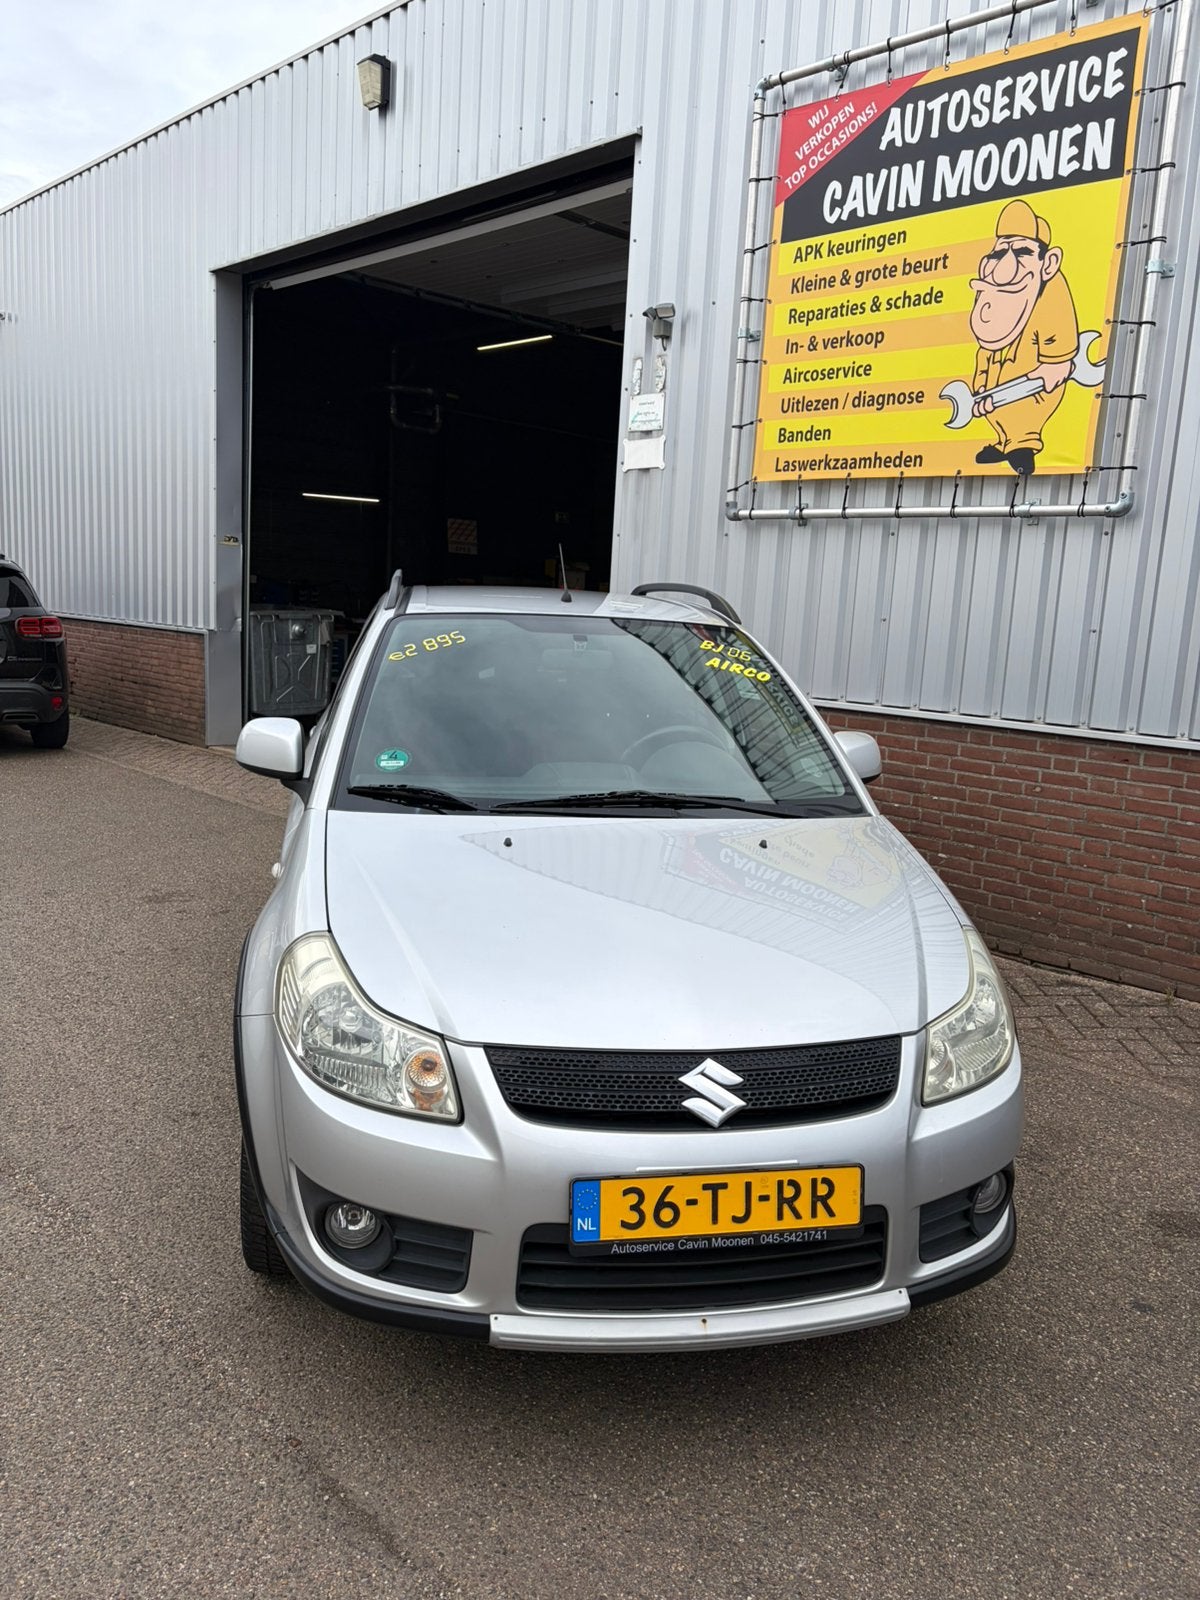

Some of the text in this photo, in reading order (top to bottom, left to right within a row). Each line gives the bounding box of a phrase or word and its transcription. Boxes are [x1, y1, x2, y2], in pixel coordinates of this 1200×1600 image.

[879, 48, 1129, 151] AUTOSERVICE
[808, 104, 830, 129] WIJ
[794, 101, 855, 161] VERKOPEN
[784, 101, 878, 190] TOP OCCASIONS!
[823, 118, 1116, 224] CAVIN MOONEN
[793, 230, 907, 264] APK keuringen
[790, 253, 948, 294] Kleine & grote beurt
[788, 286, 944, 326] Reparaties & schade
[785, 330, 885, 355] In- & verkoop
[783, 361, 872, 384] Aircoservice
[780, 389, 925, 413] Uitlezen / diagnose
[777, 425, 832, 444] Banden
[774, 450, 924, 473] Laswerkzaamheden
[699, 639, 753, 663] BJ 06
[704, 656, 773, 684] AIRCO
[620, 1177, 836, 1230] 36-TJ-RR
[577, 1217, 597, 1231] NL
[611, 1230, 827, 1254] Autoservice Cavin Moonen 045-5421741
